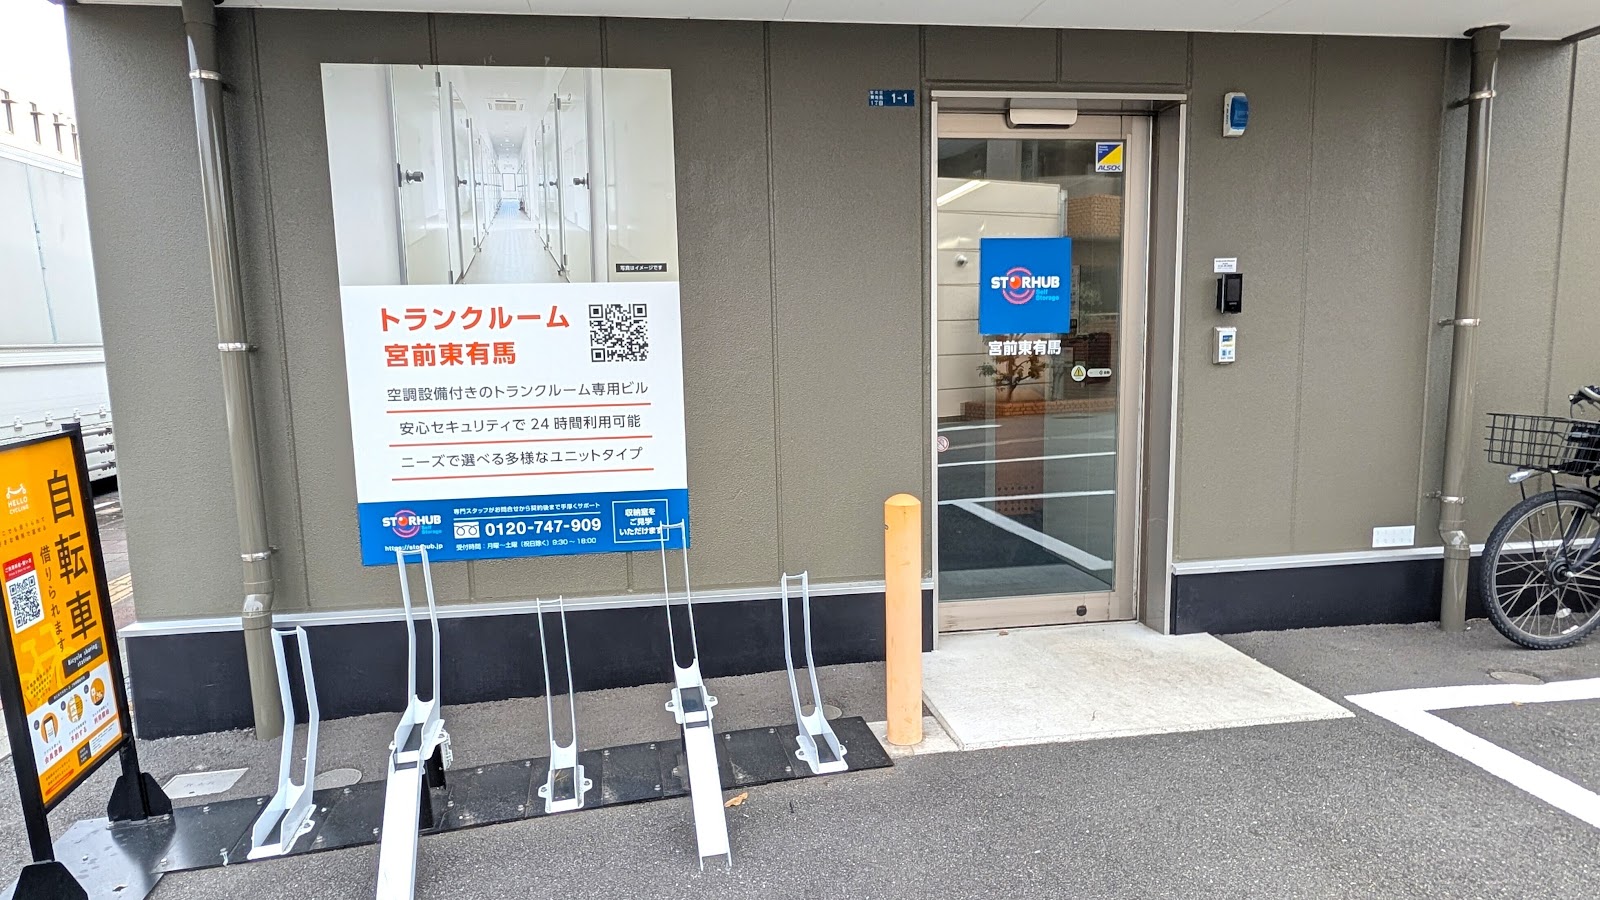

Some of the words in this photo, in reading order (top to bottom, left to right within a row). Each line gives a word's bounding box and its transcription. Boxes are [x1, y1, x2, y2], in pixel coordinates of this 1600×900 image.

[891, 93, 908, 104] 1-1
[990, 275, 1061, 289] STORHUB
[380, 304, 570, 332] トランクルーム
[384, 341, 517, 368] 宮前東有馬
[988, 339, 1062, 356] 宮前東有馬
[386, 381, 649, 403] 空調設備付きのトランクルーム専用ビル
[400, 418, 526, 436] 安心セキュリティで
[530, 417, 550, 430] 24
[553, 413, 642, 431] 時間利用可能
[401, 446, 644, 469] ニーズで選べる多様なユニットタイプ
[8, 496, 28, 509] HELLO
[9, 504, 29, 515] CYCLING
[381, 514, 442, 527] STORHUB
[624, 507, 656, 517] 収納室を
[485, 517, 602, 537] 0120-747-909
[629, 517, 653, 526] ご見学
[47, 469, 98, 640] 自転車
[40, 545, 66, 653] 借りられます
[67, 652, 83, 666] Bicycle
[83, 638, 98, 655] sharing
[76, 655, 92, 668] station
